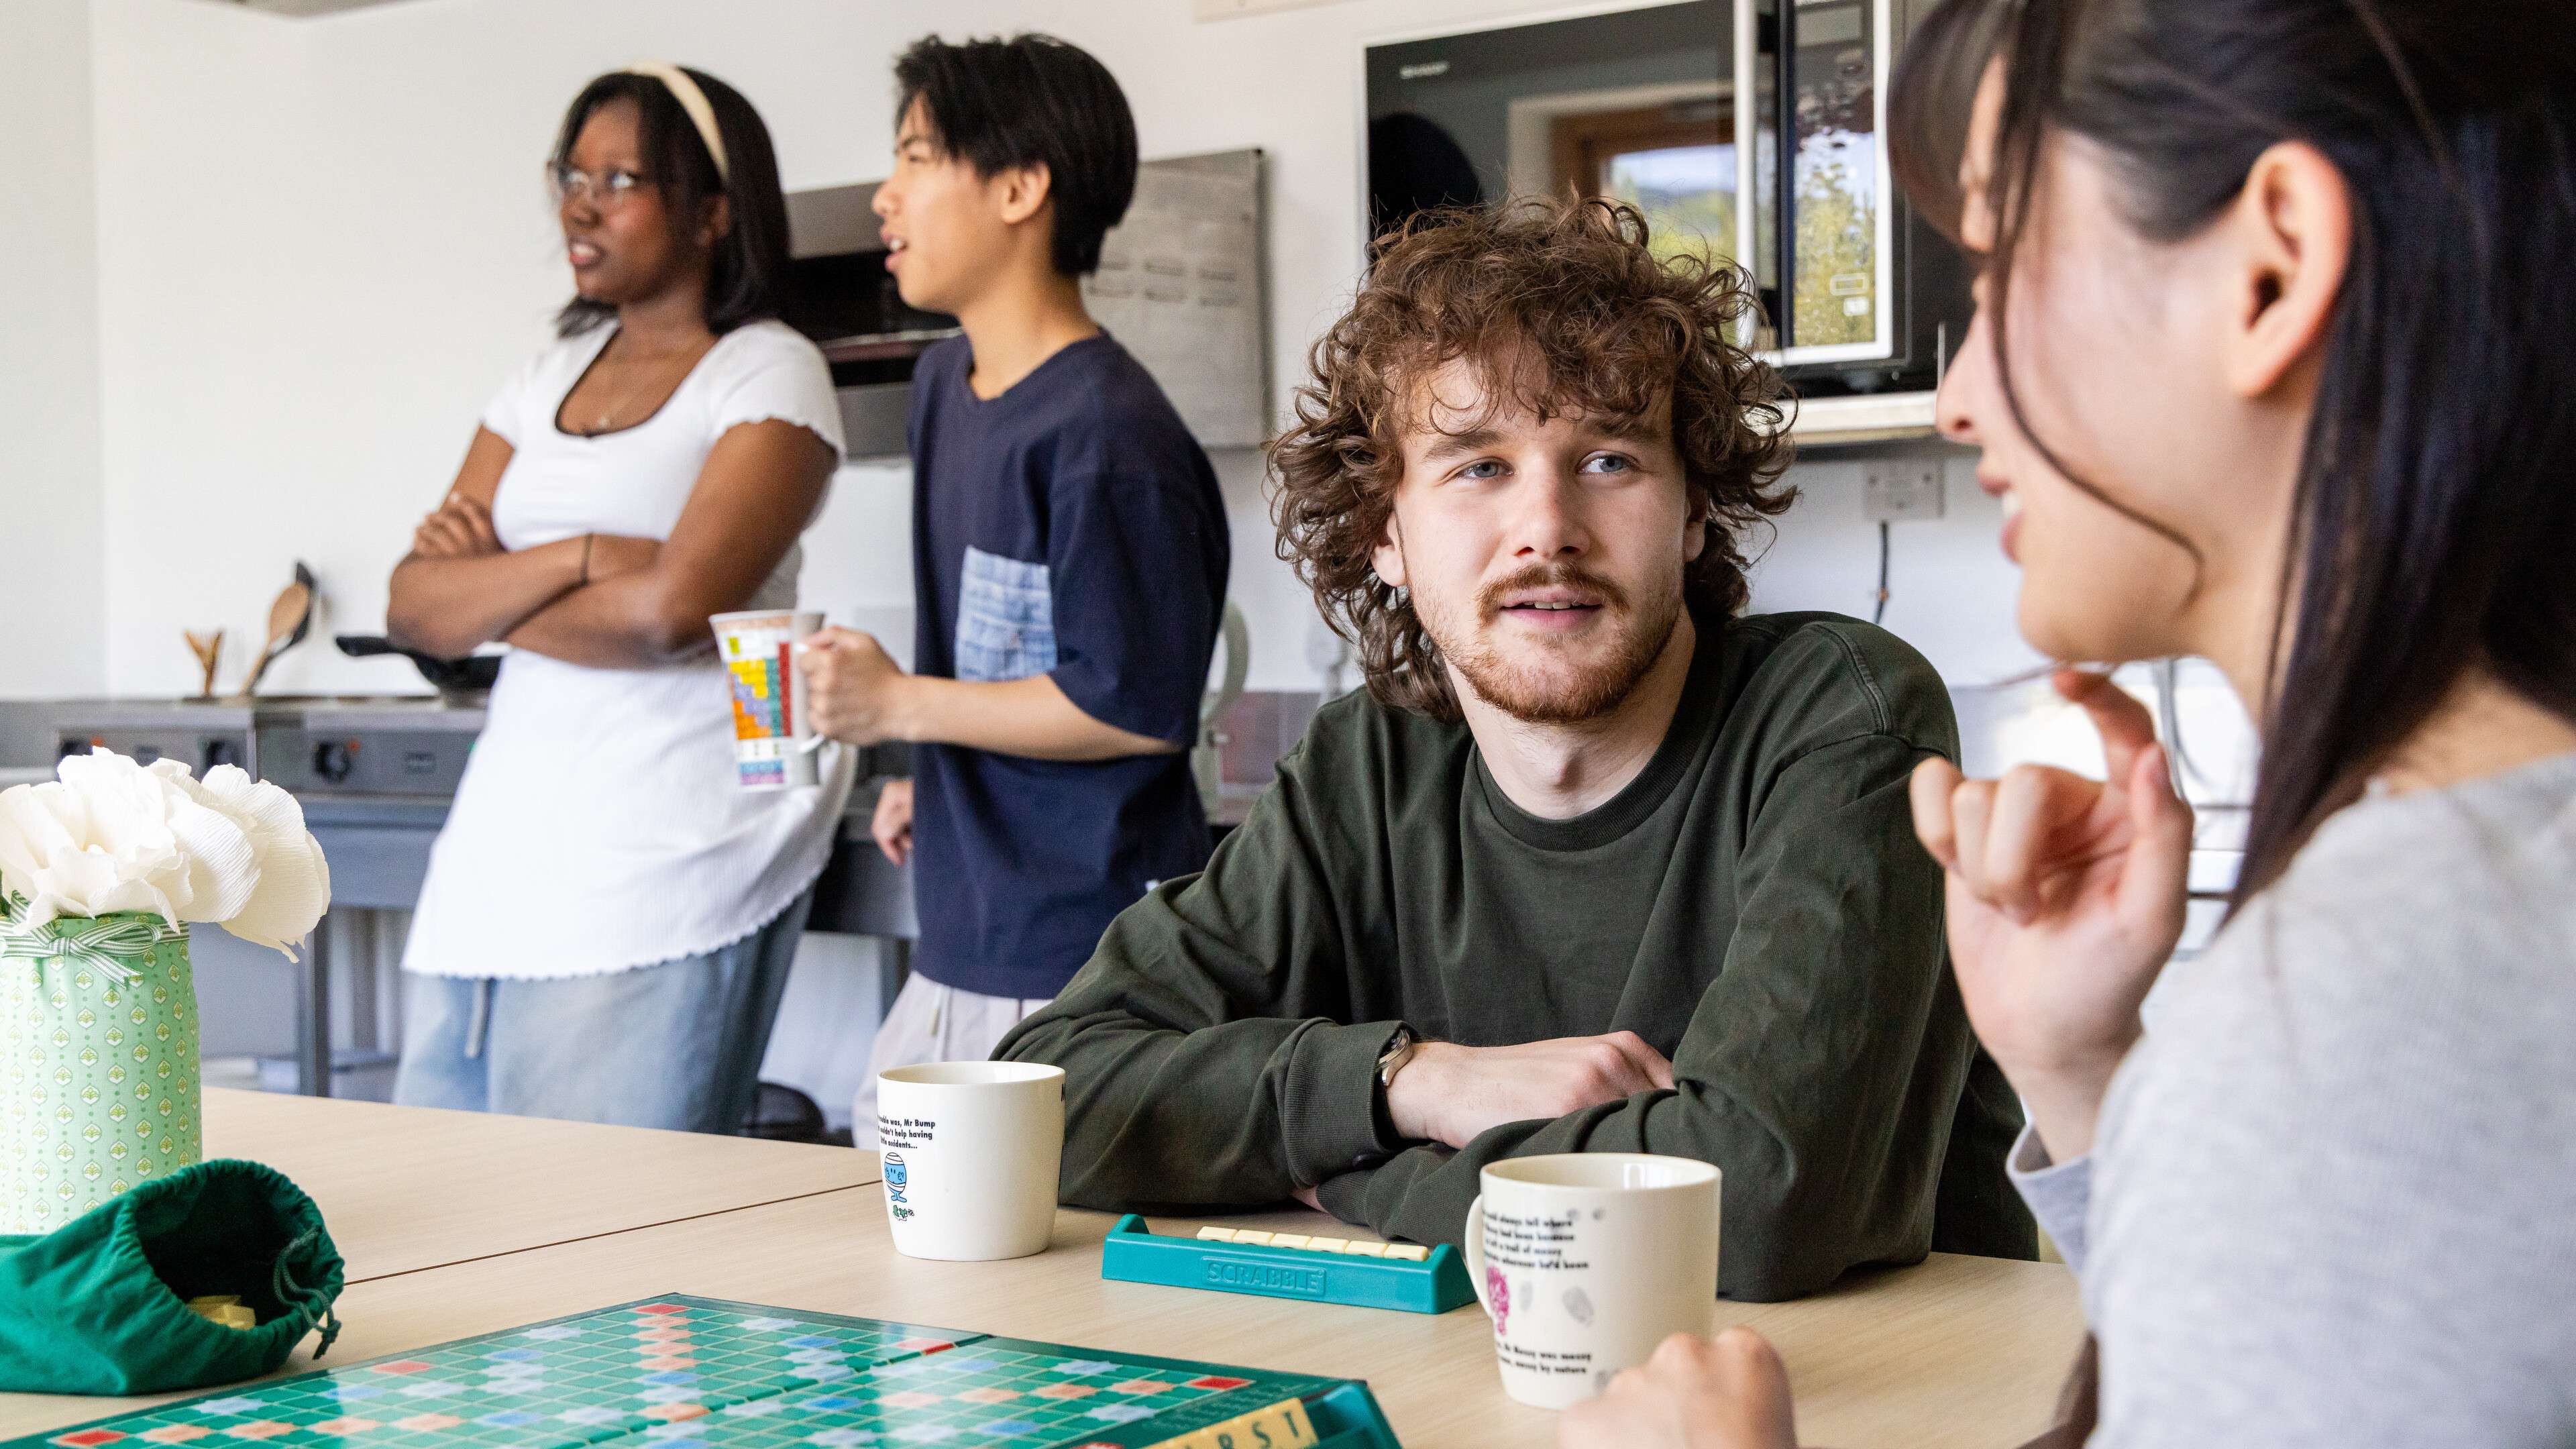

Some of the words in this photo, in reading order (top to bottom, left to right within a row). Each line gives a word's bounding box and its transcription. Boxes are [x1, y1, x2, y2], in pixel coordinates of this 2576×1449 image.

[890, 1119, 902, 1127] was,
[904, 1118, 912, 1127] Mr
[914, 1119, 935, 1129] Bump
[894, 1128, 907, 1139] help
[909, 1130, 932, 1140] having
[888, 1140, 918, 1148] accidents...
[1208, 1262, 1320, 1293] SCRABBLE
